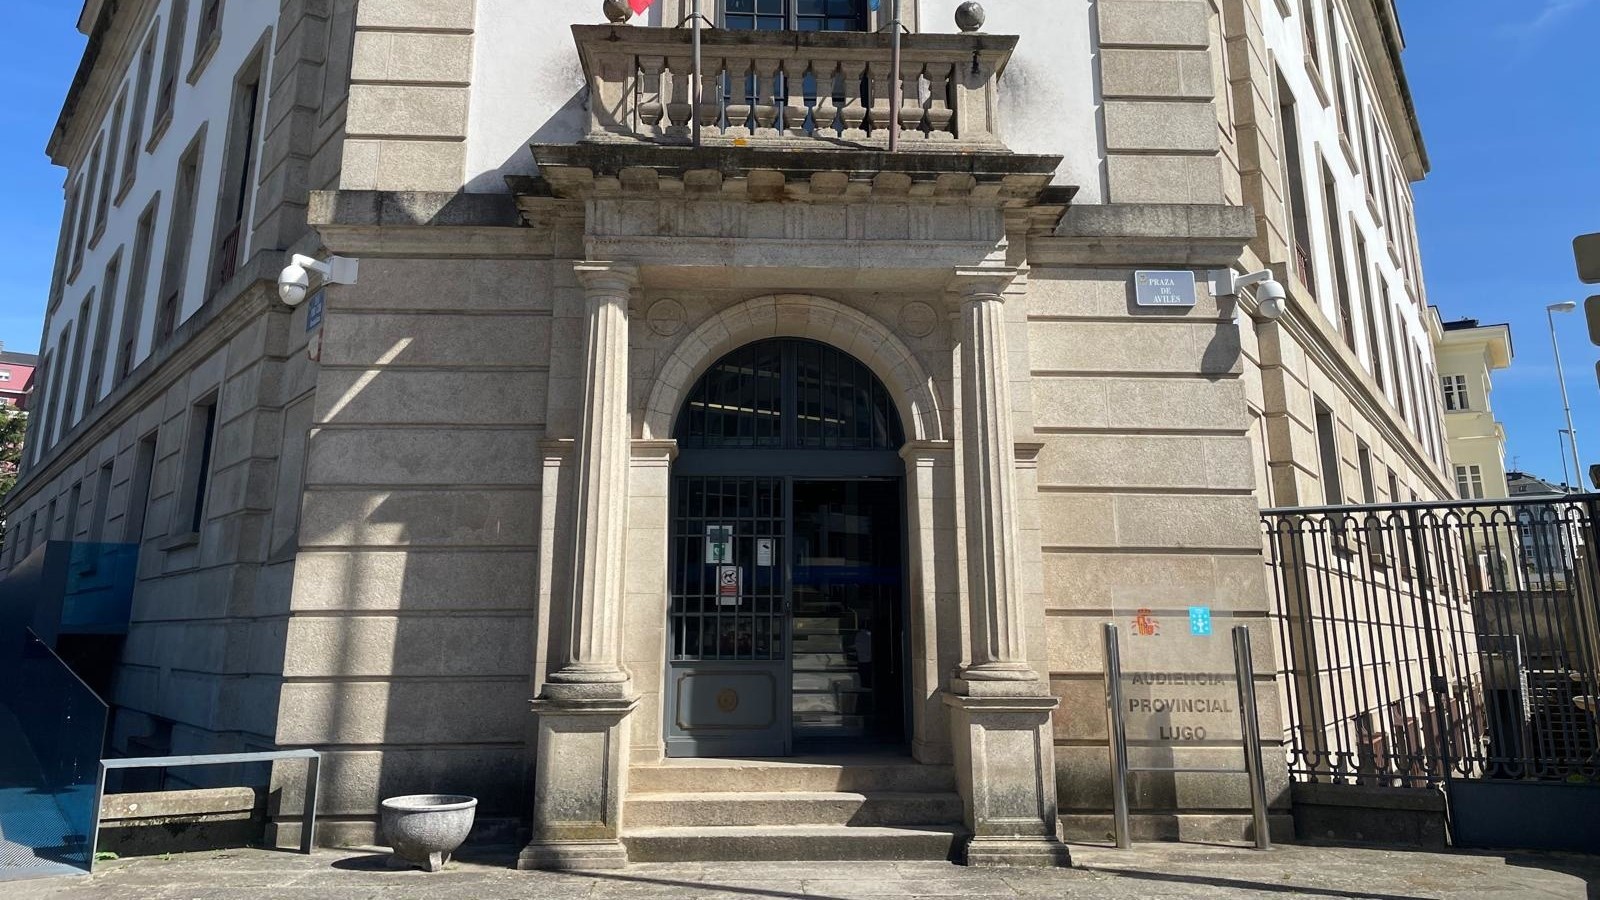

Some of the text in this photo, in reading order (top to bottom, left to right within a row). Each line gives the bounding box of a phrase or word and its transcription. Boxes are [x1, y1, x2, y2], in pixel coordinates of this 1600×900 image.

[1149, 278, 1175, 286] PRAZA
[1160, 287, 1172, 295] DE
[1131, 672, 1226, 686] AUDIENCIA
[1129, 698, 1233, 713] PROVINCIAL
[1159, 726, 1207, 740] LUGO
